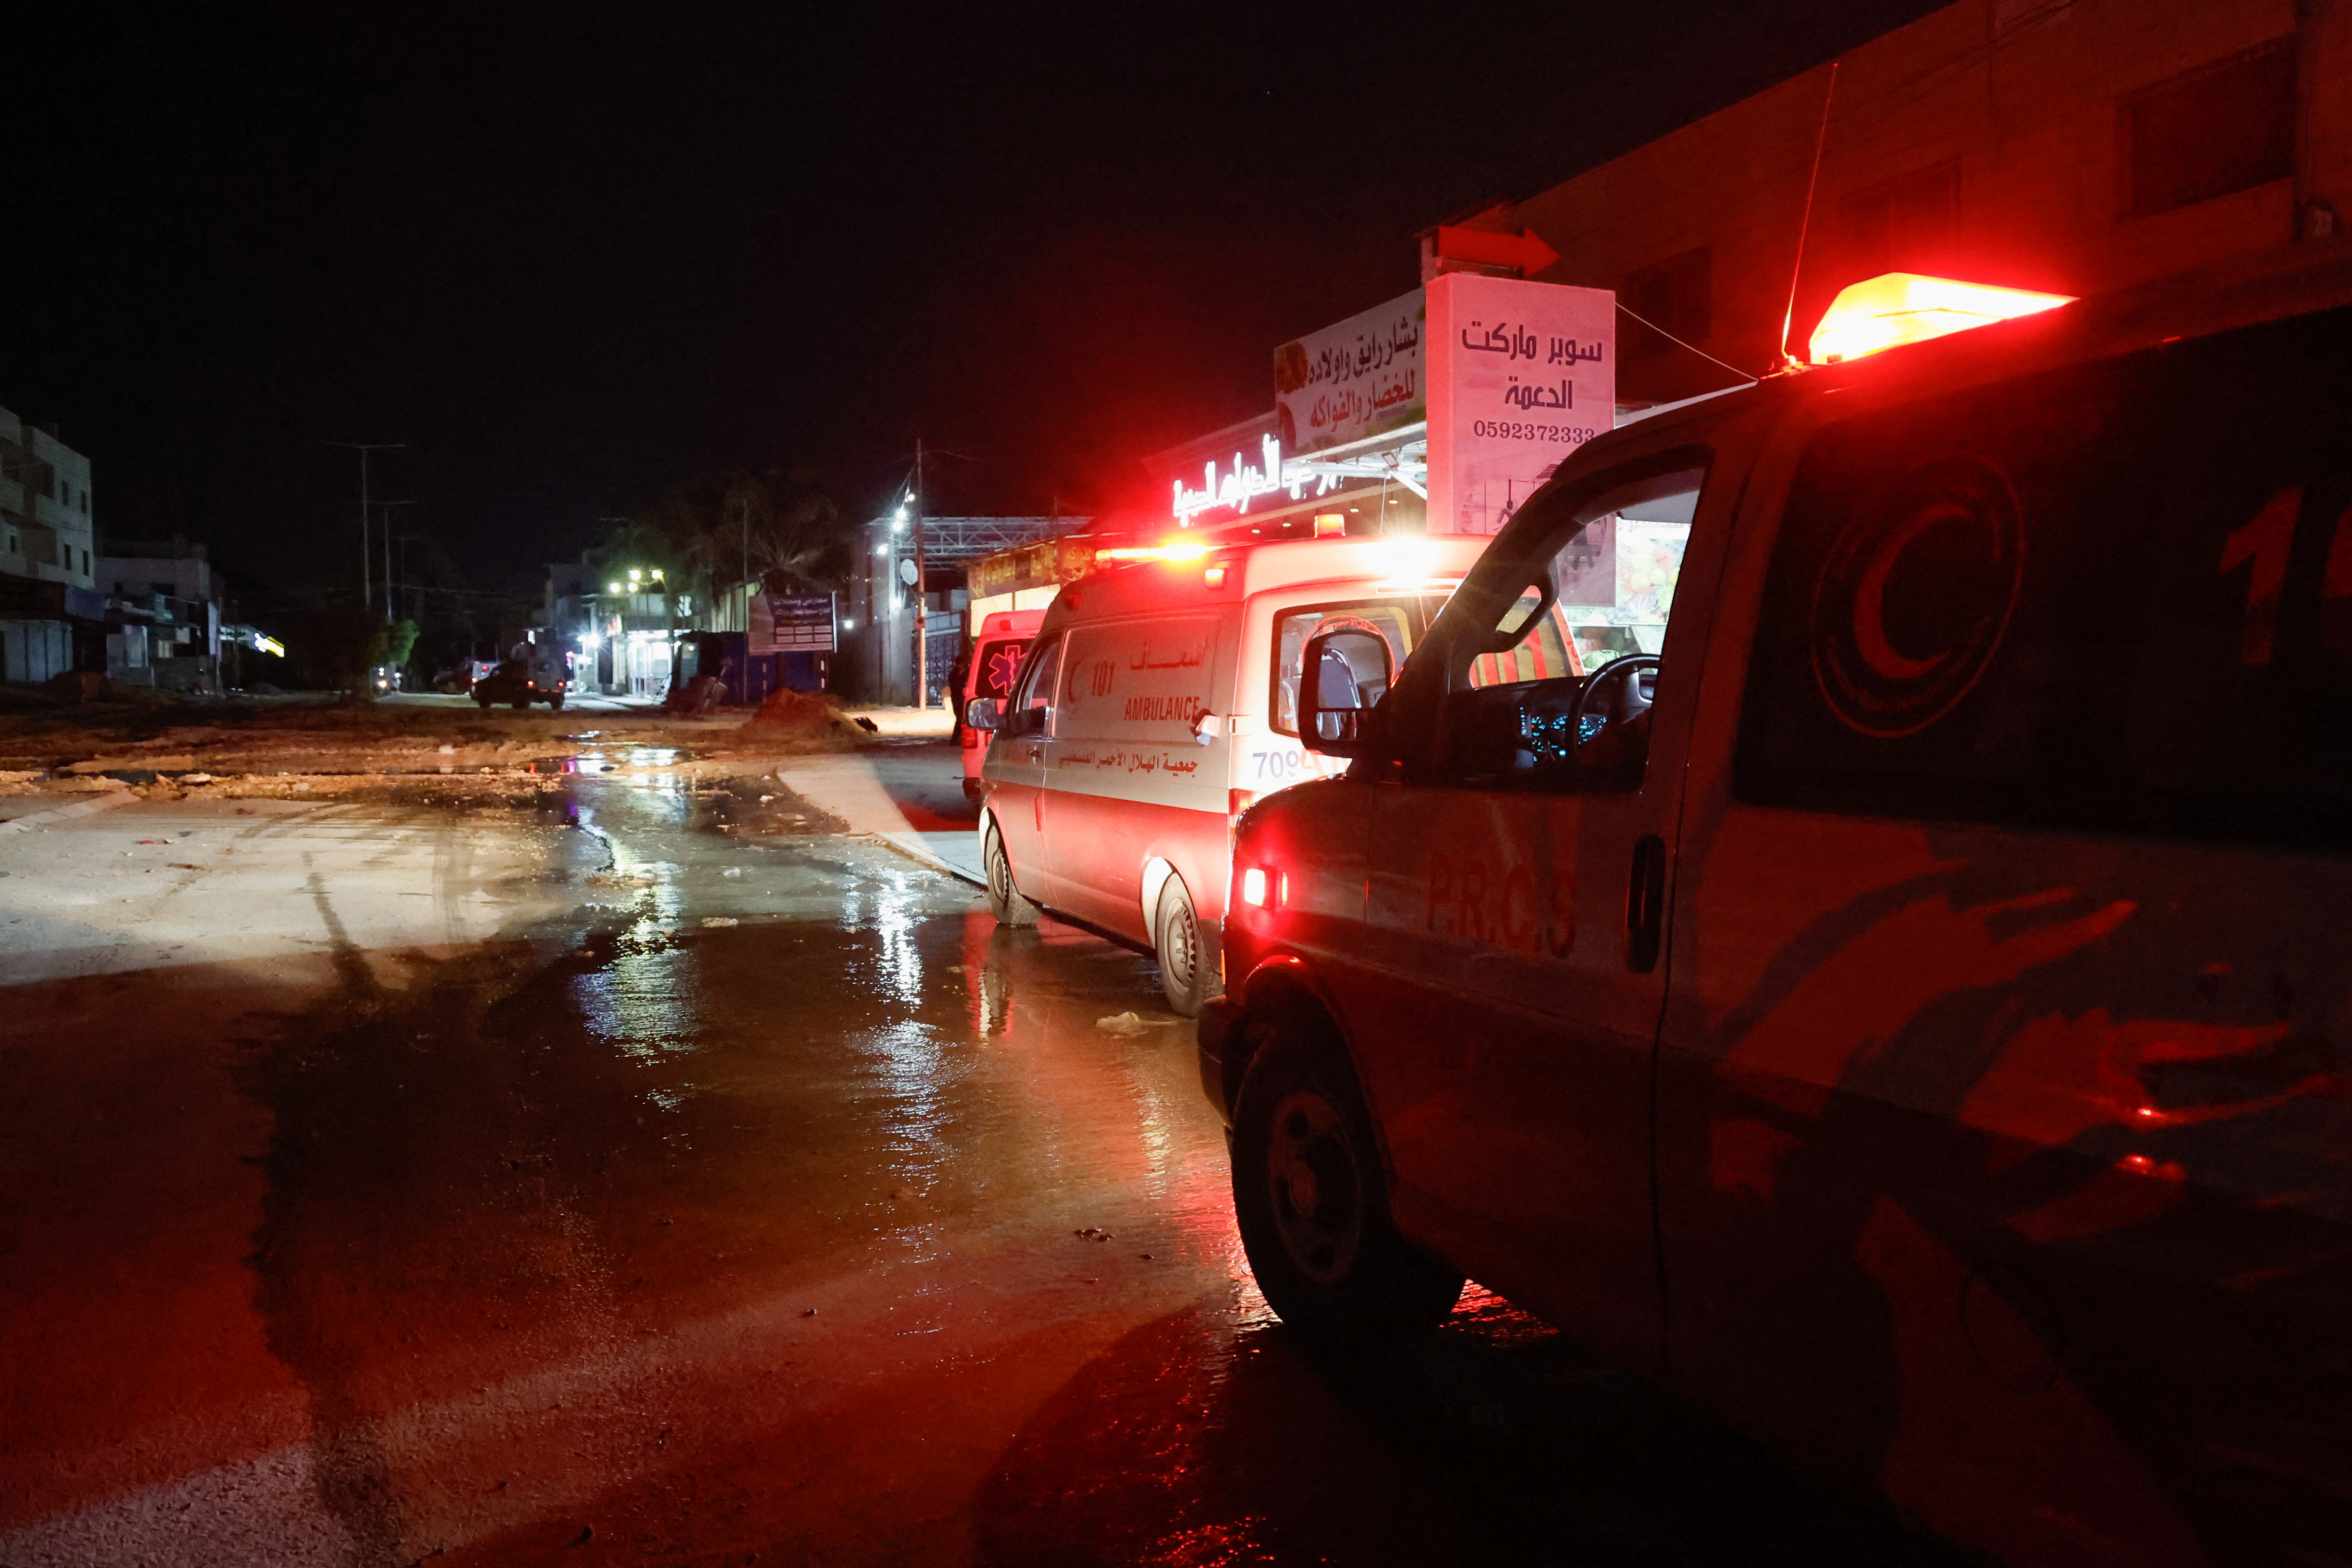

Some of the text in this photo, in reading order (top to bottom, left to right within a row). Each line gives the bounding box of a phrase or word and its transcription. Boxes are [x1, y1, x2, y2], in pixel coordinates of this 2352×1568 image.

[1382, 315, 1418, 366] بشار
[1462, 321, 1602, 366] سوبر ماركت
[1364, 367, 1415, 422] للخضار
[1505, 376, 1573, 410] الدعمة
[1474, 420, 1595, 444] 0592372333
[1091, 661, 1115, 697] 101
[1124, 696, 1200, 721] AMBULANCE
[1128, 753, 1159, 773] الهلال
[1163, 752, 1198, 778] جمعية
